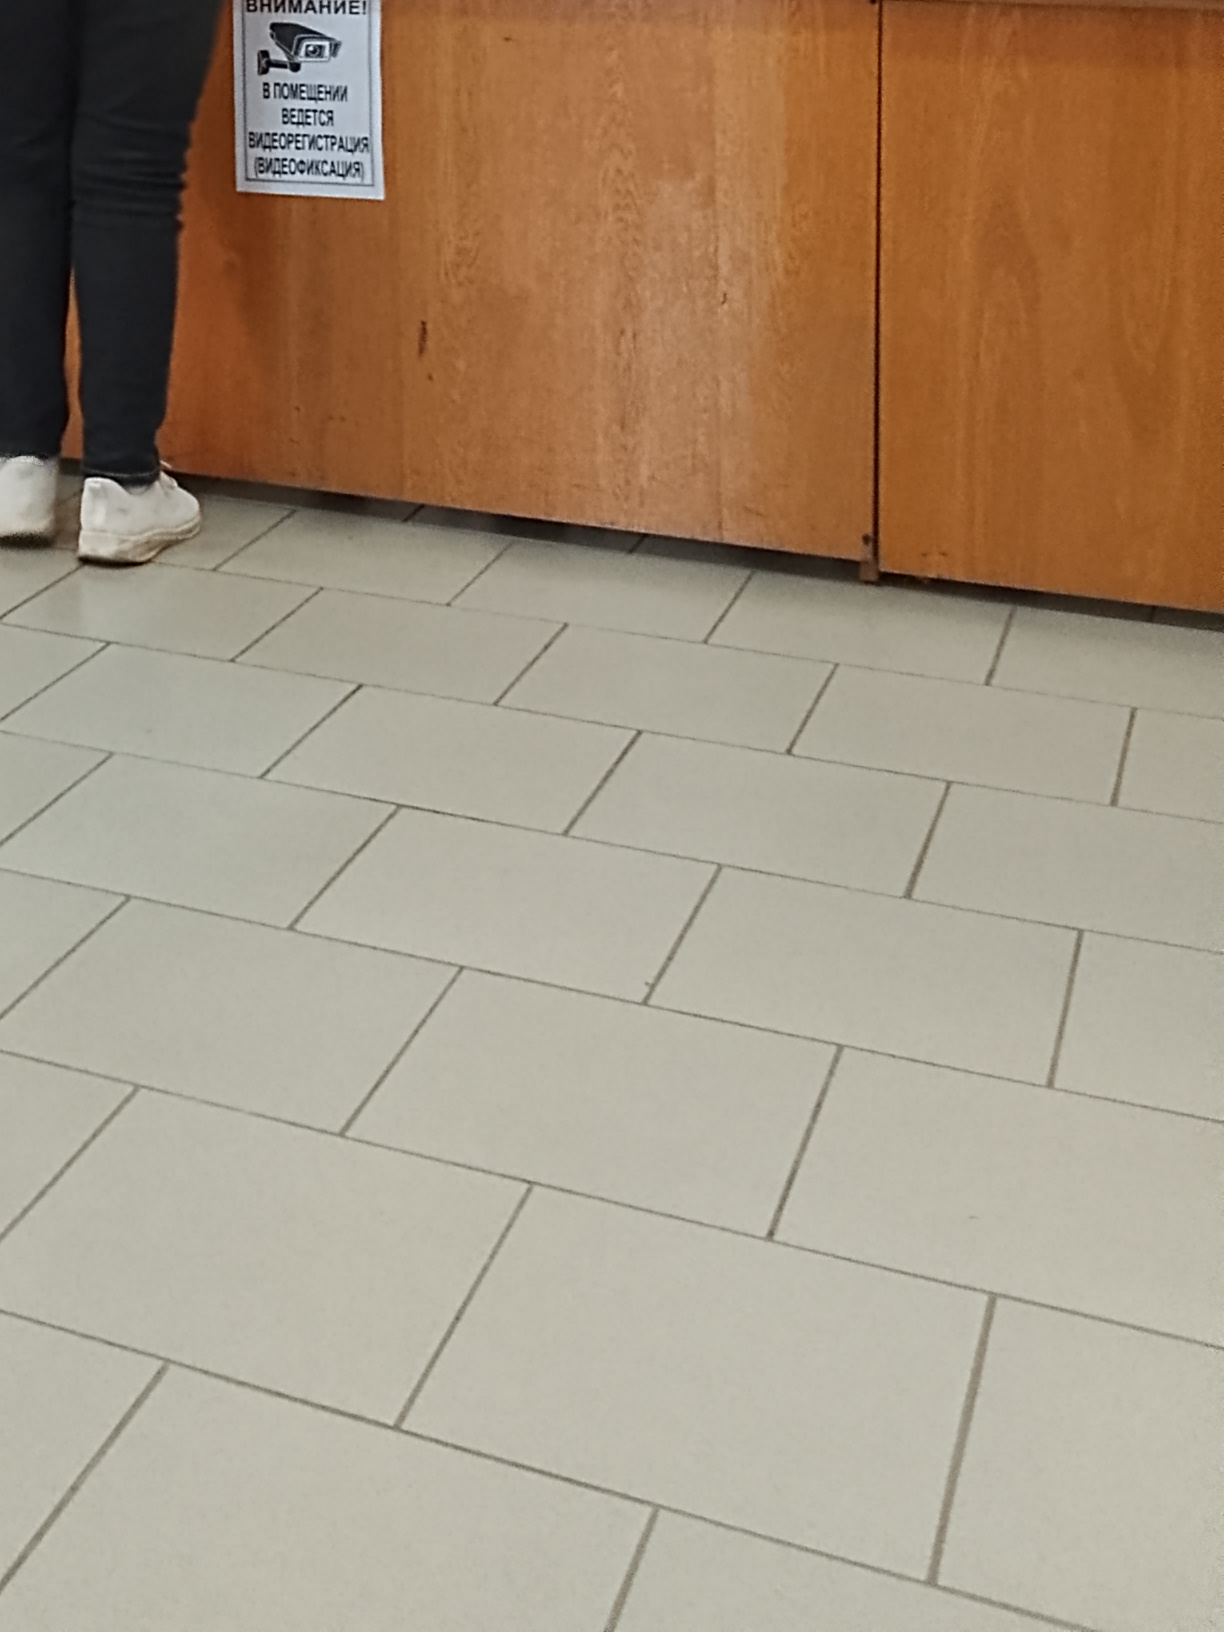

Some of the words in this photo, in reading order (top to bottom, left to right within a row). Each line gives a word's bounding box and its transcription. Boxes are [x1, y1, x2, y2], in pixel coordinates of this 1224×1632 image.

[262, 82, 271, 99] В
[273, 82, 348, 103] ПОМЕЩЕНИИ
[282, 107, 334, 126] ВЕДЕТСЯ
[248, 132, 369, 155] ВИДЕОРЕГИСТРАЦИЯ
[254, 157, 364, 183] (ВИДЕОФИКСАЦИЯ)
